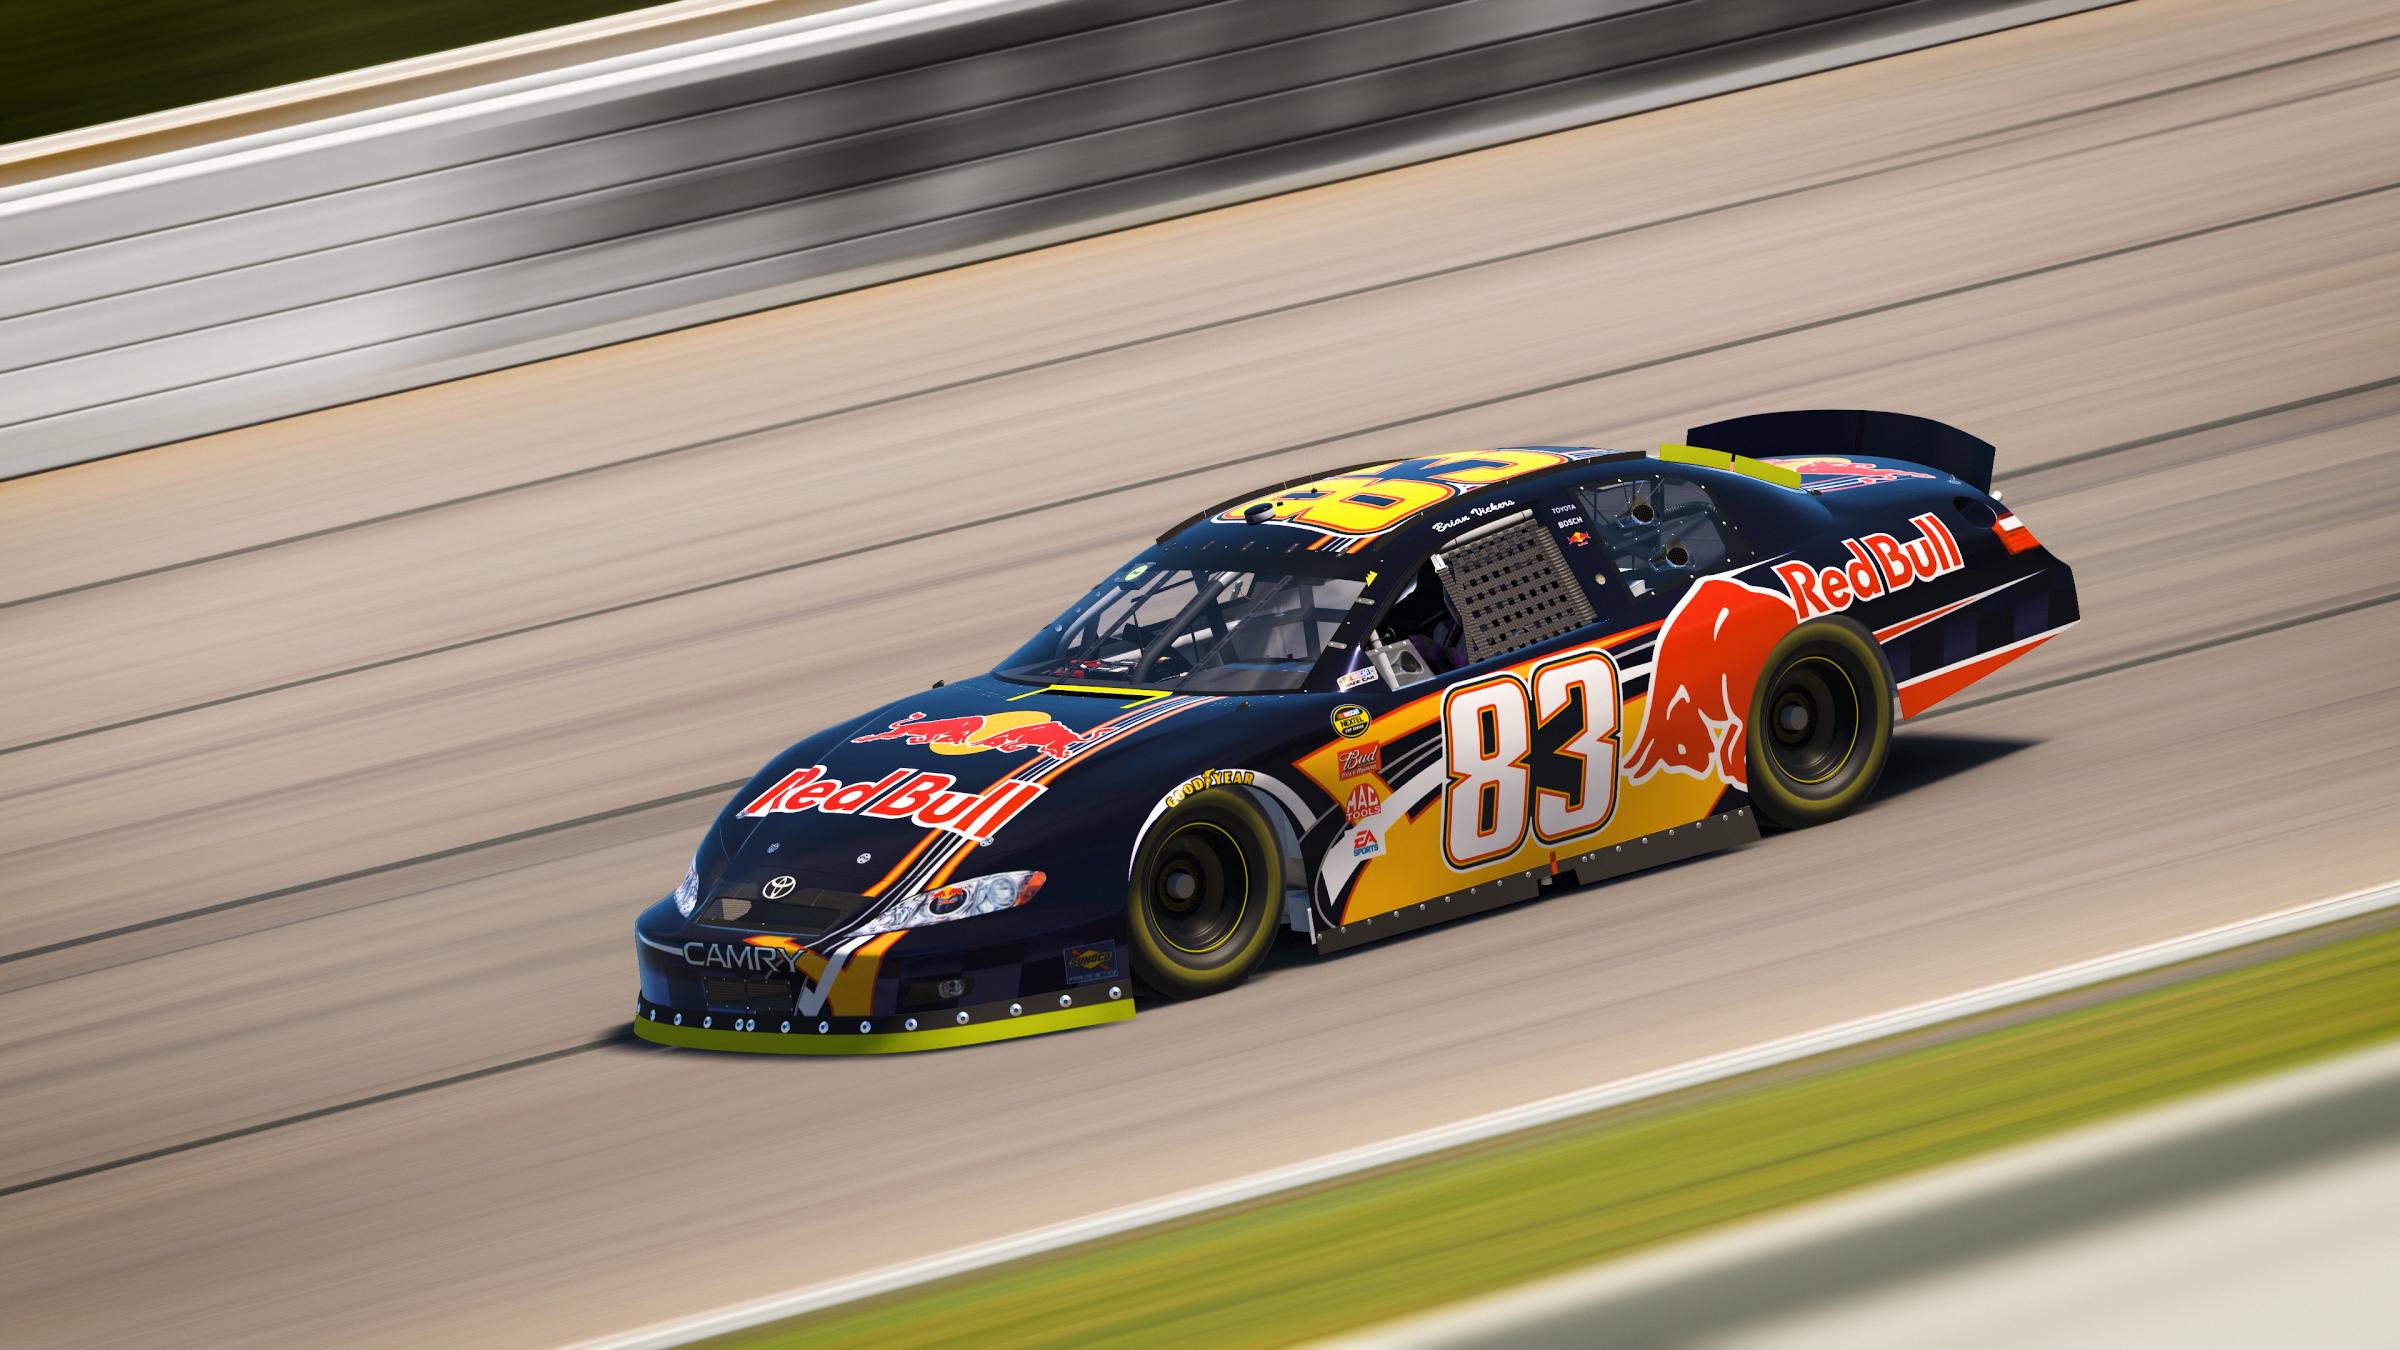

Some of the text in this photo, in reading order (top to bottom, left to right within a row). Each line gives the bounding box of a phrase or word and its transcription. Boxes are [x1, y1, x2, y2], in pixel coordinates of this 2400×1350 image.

[1209, 449, 1572, 541] 83
[1551, 504, 1577, 514] TOYOTA
[1431, 500, 1516, 532] Brian Vickers
[1558, 516, 1584, 529] BOSCH
[1770, 511, 1966, 624] Red Bull
[1340, 716, 1364, 728] NEXTEL
[1339, 745, 1379, 771] Bud
[1441, 647, 1624, 873] 83
[1166, 768, 1255, 808] GOODYEAR
[1347, 784, 1379, 813] MAC
[739, 765, 1047, 841] Red Bull
[1346, 805, 1381, 821] TOOLS
[1354, 829, 1378, 849] EA
[1354, 844, 1379, 857] SPORTS
[683, 941, 806, 973] CAMRY
